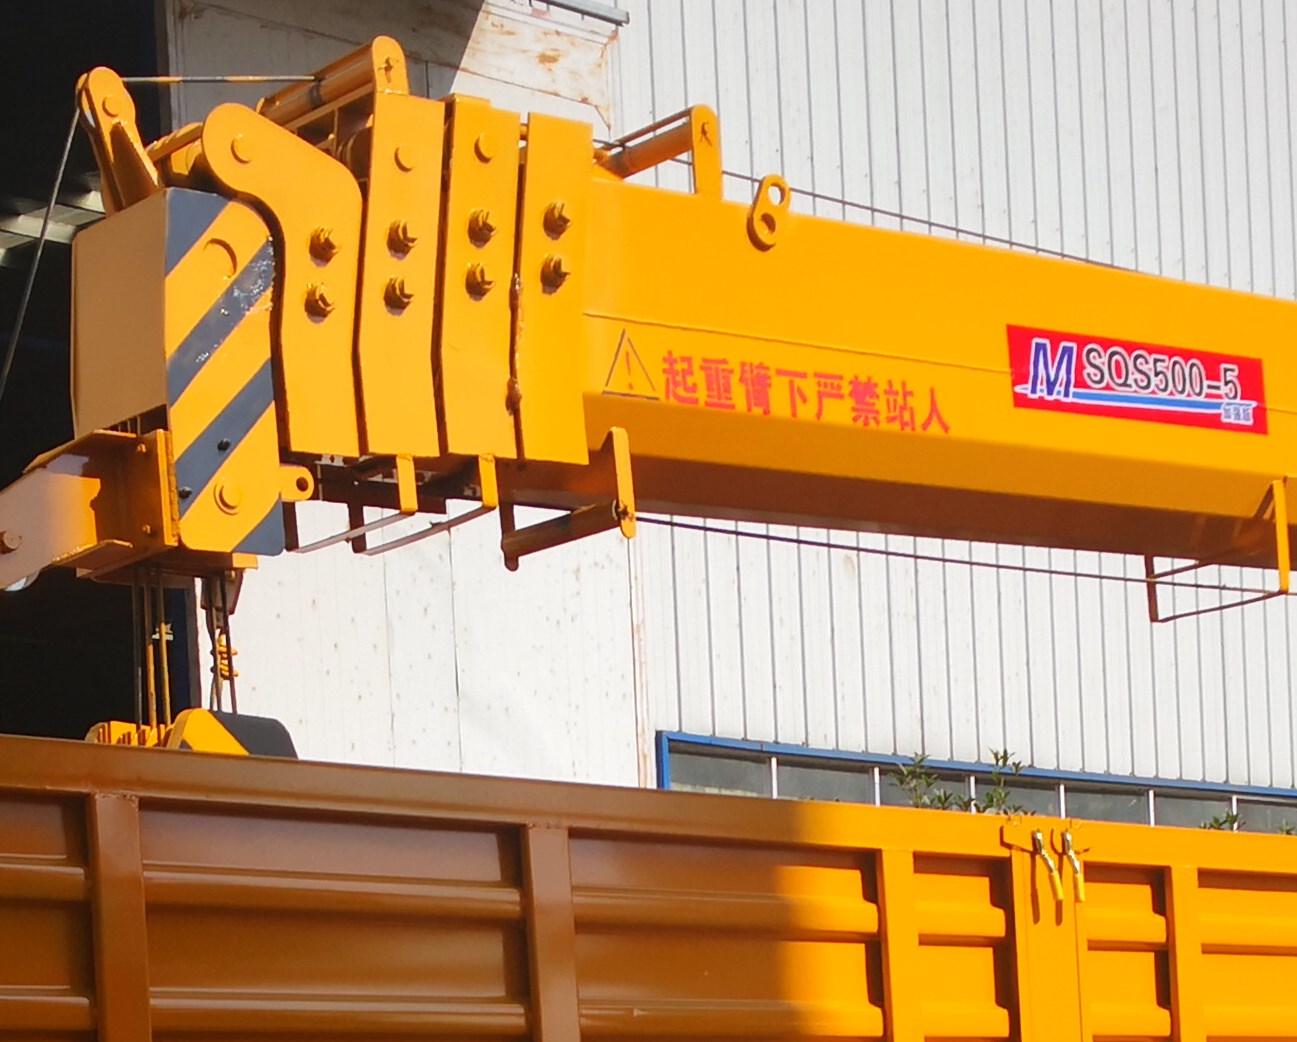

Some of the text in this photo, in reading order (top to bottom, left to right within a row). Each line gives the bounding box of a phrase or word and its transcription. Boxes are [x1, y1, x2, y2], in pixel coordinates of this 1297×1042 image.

[662, 350, 951, 434] 起重臂下严禁站人
[1084, 347, 1239, 400] SQS500-5
